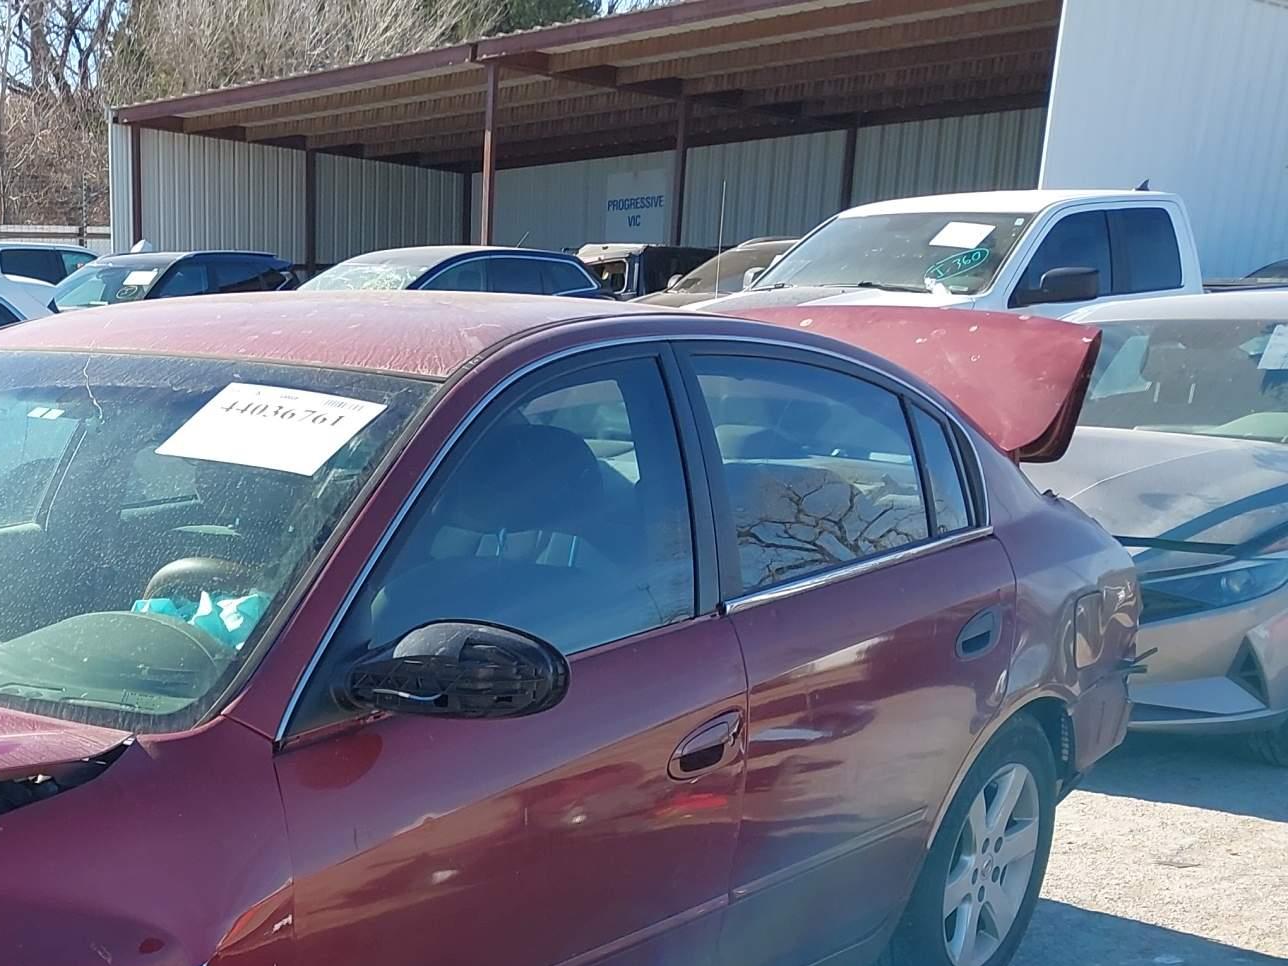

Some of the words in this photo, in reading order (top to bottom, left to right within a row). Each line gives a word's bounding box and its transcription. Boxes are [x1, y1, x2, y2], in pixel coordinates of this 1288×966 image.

[607, 195, 665, 212] PROGRESSIVE
[627, 215, 641, 228] VIC
[221, 400, 345, 426] 44036761
